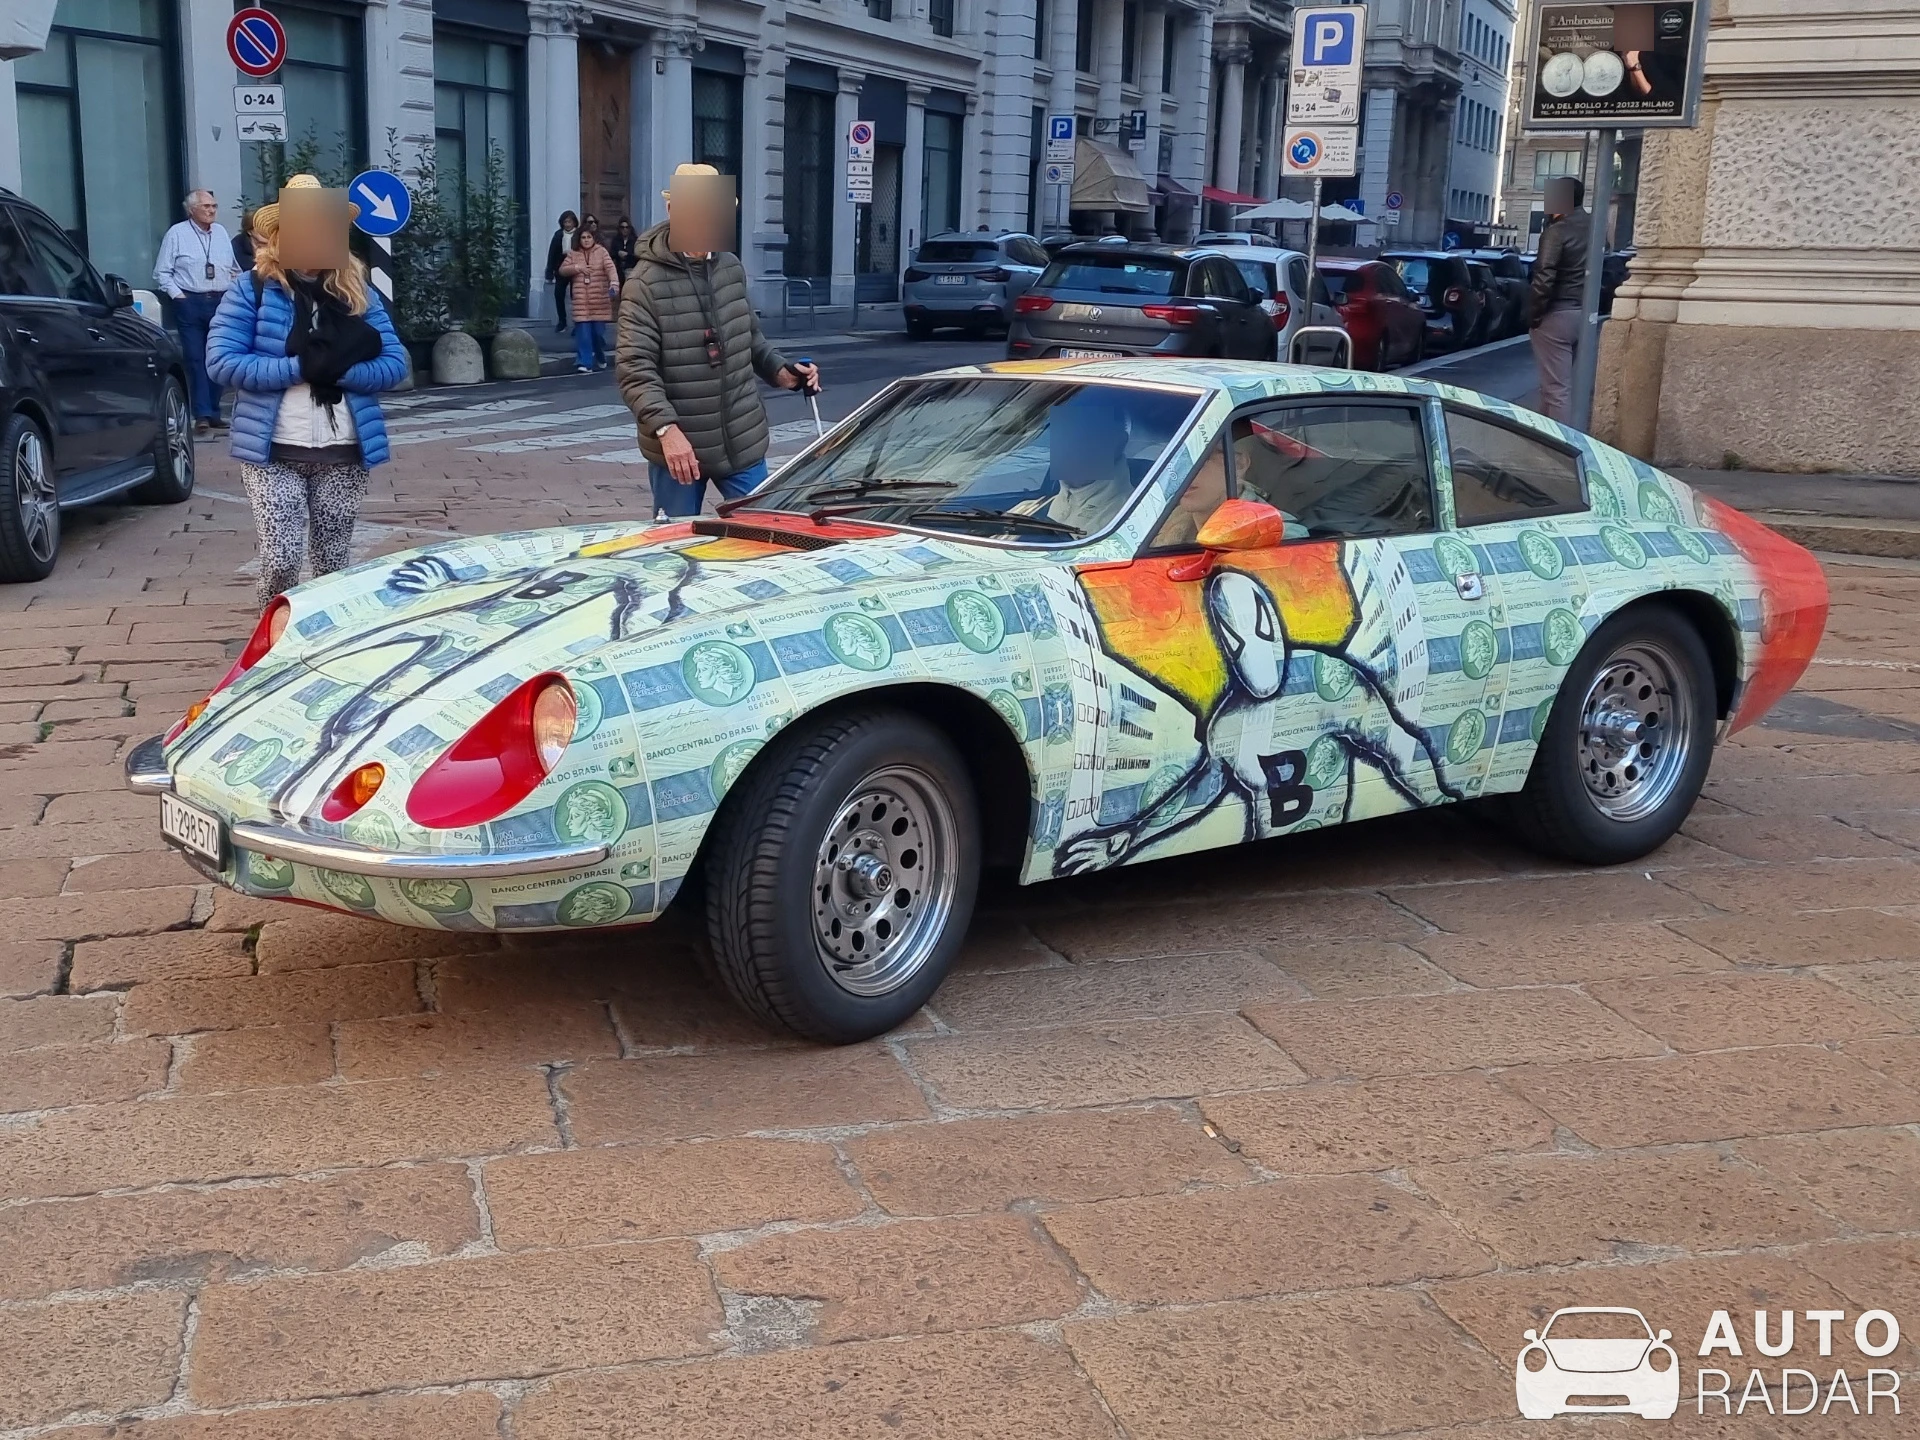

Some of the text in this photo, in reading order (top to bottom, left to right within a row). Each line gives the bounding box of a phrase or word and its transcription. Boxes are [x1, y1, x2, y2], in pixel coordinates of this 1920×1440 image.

[1557, 14, 1614, 26] Ambrosiano
[1313, 21, 1344, 62] P
[243, 93, 275, 106] 0-24
[1291, 103, 1300, 113] 19
[1305, 102, 1317, 112] 24
[1641, 100, 1675, 108] MILANO
[1055, 121, 1068, 138] P
[1127, 524, 1138, 539] DO
[887, 589, 911, 599] BANCO
[911, 585, 941, 595] CENTRAL
[950, 579, 973, 588] BRASIL
[759, 614, 786, 625] BANCO
[786, 609, 818, 620] CENTRAL
[818, 605, 830, 613] DO
[830, 600, 855, 610] BRASIL
[613, 647, 642, 660] BANCO
[643, 640, 680, 652] CENTRAL
[680, 635, 692, 643] DO
[693, 628, 722, 639] BRASIL
[646, 746, 675, 761] BANCO
[676, 736, 714, 752] CENTRAL
[714, 732, 728, 742] DO
[729, 723, 760, 738] BRASIL
[557, 771, 571, 781] DO
[572, 763, 604, 778] BRASIL
[1257, 750, 1313, 828] B
[453, 831, 481, 843] BAN
[490, 884, 525, 894] BANCO
[526, 877, 568, 891] CENTRAL
[569, 873, 583, 883] DO
[584, 867, 616, 880] BRASIL
